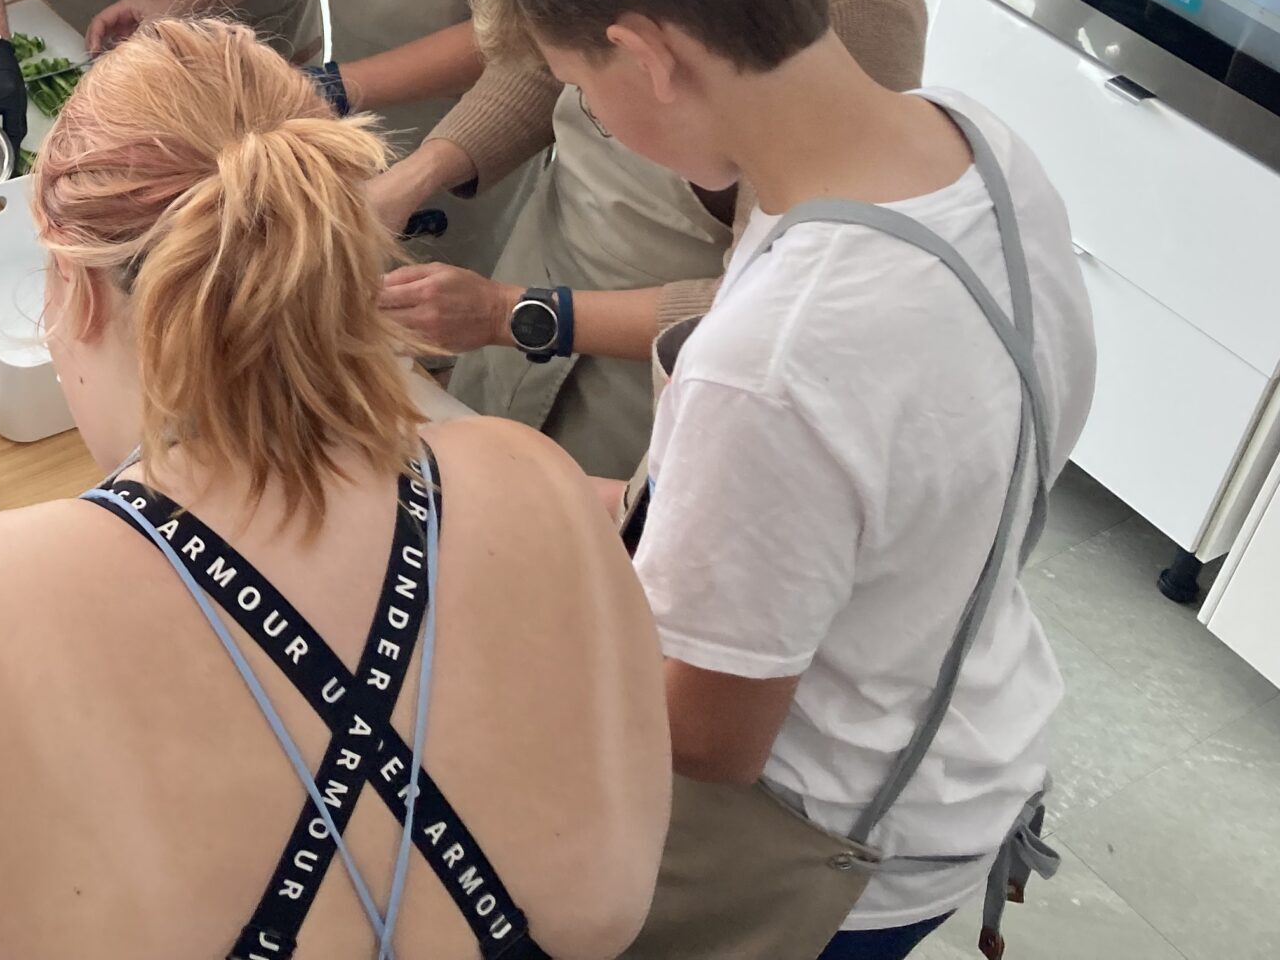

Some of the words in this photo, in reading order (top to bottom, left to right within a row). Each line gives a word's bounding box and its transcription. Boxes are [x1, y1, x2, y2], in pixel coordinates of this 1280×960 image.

[367, 544, 423, 690] UNDER
[157, 518, 308, 665] ARMOUR
[424, 821, 512, 939] ARMOU
[279, 714, 372, 900] ARMOUR
